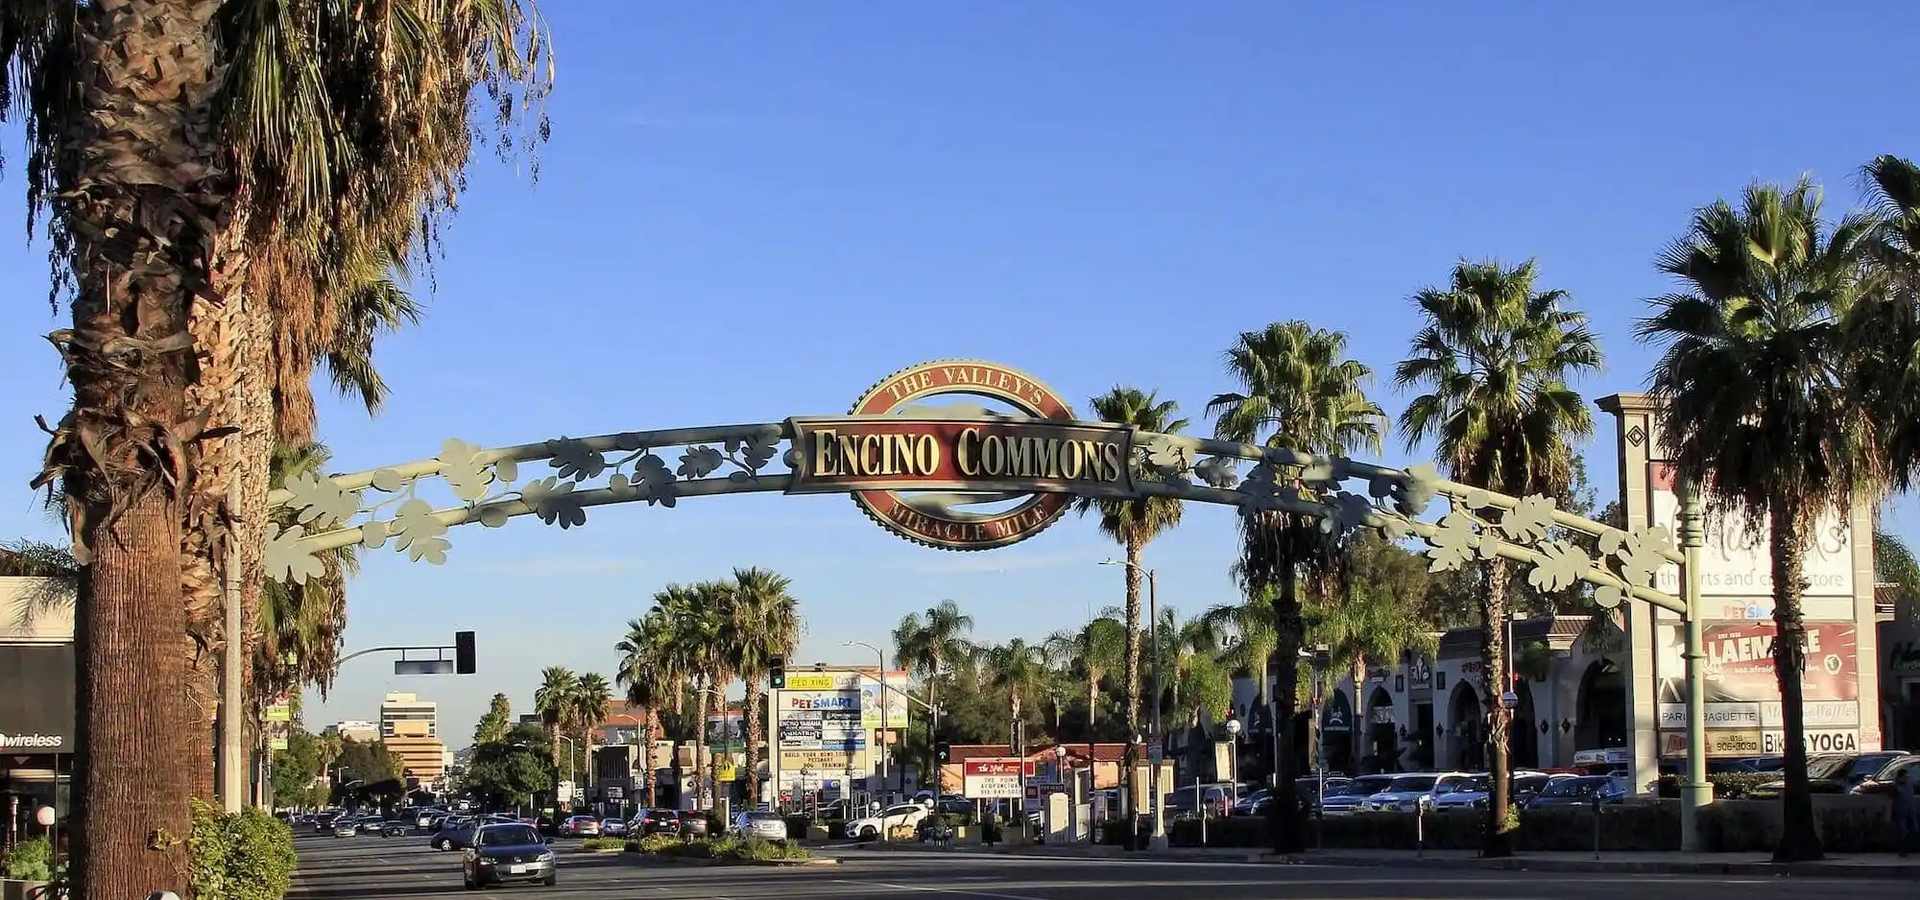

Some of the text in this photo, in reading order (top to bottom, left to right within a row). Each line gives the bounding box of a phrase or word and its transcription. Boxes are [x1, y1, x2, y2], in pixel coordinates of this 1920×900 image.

[887, 367, 1045, 405] THE VALLEY'S
[888, 502, 1047, 541] MIRACLE MILE
[1723, 570, 1753, 586] and
[791, 678, 807, 687] PED
[810, 678, 830, 687] XING
[1662, 712, 1689, 721] PARI
[5, 733, 62, 747] wireless
[1809, 733, 1856, 751] YOGA
